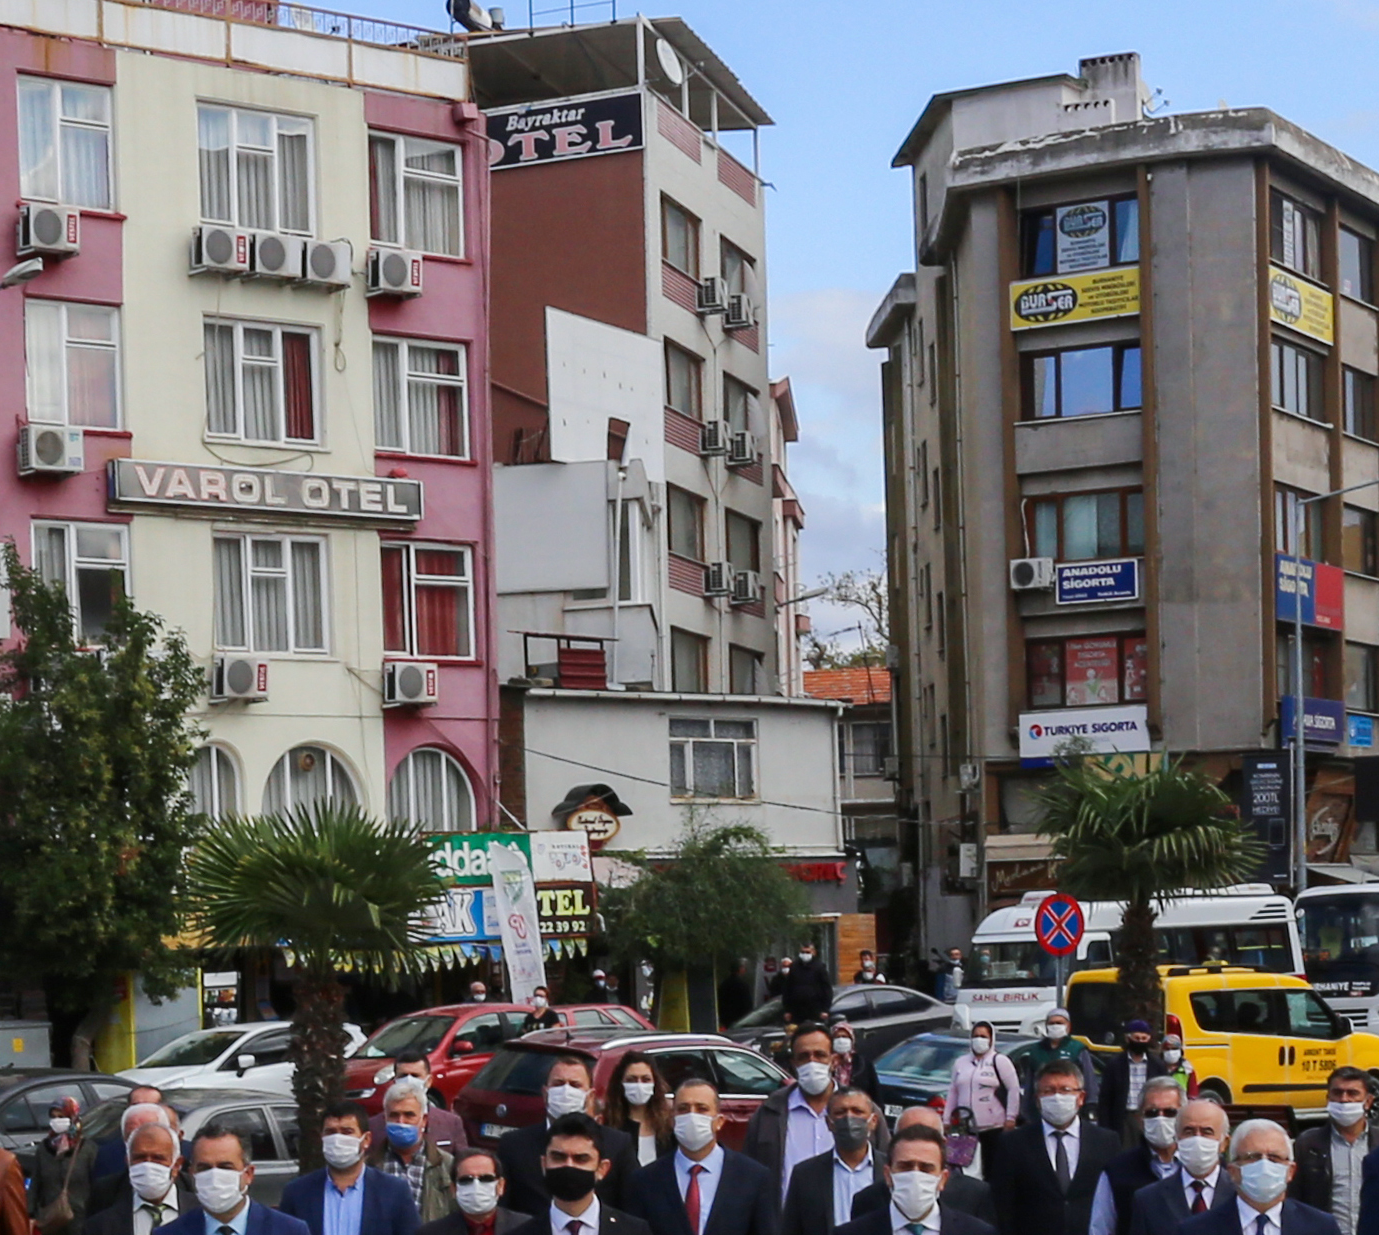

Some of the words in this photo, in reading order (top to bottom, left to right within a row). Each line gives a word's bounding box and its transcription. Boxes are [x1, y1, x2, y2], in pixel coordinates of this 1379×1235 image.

[506, 108, 586, 131] Bayraktar
[135, 465, 286, 505] VAROL
[301, 477, 408, 513] OTEL
[1062, 564, 1121, 577] ANADOLU
[1062, 577, 1115, 589] SİGORTA
[540, 921, 554, 933] 22
[556, 921, 569, 932] 39
[572, 920, 585, 932] 92
